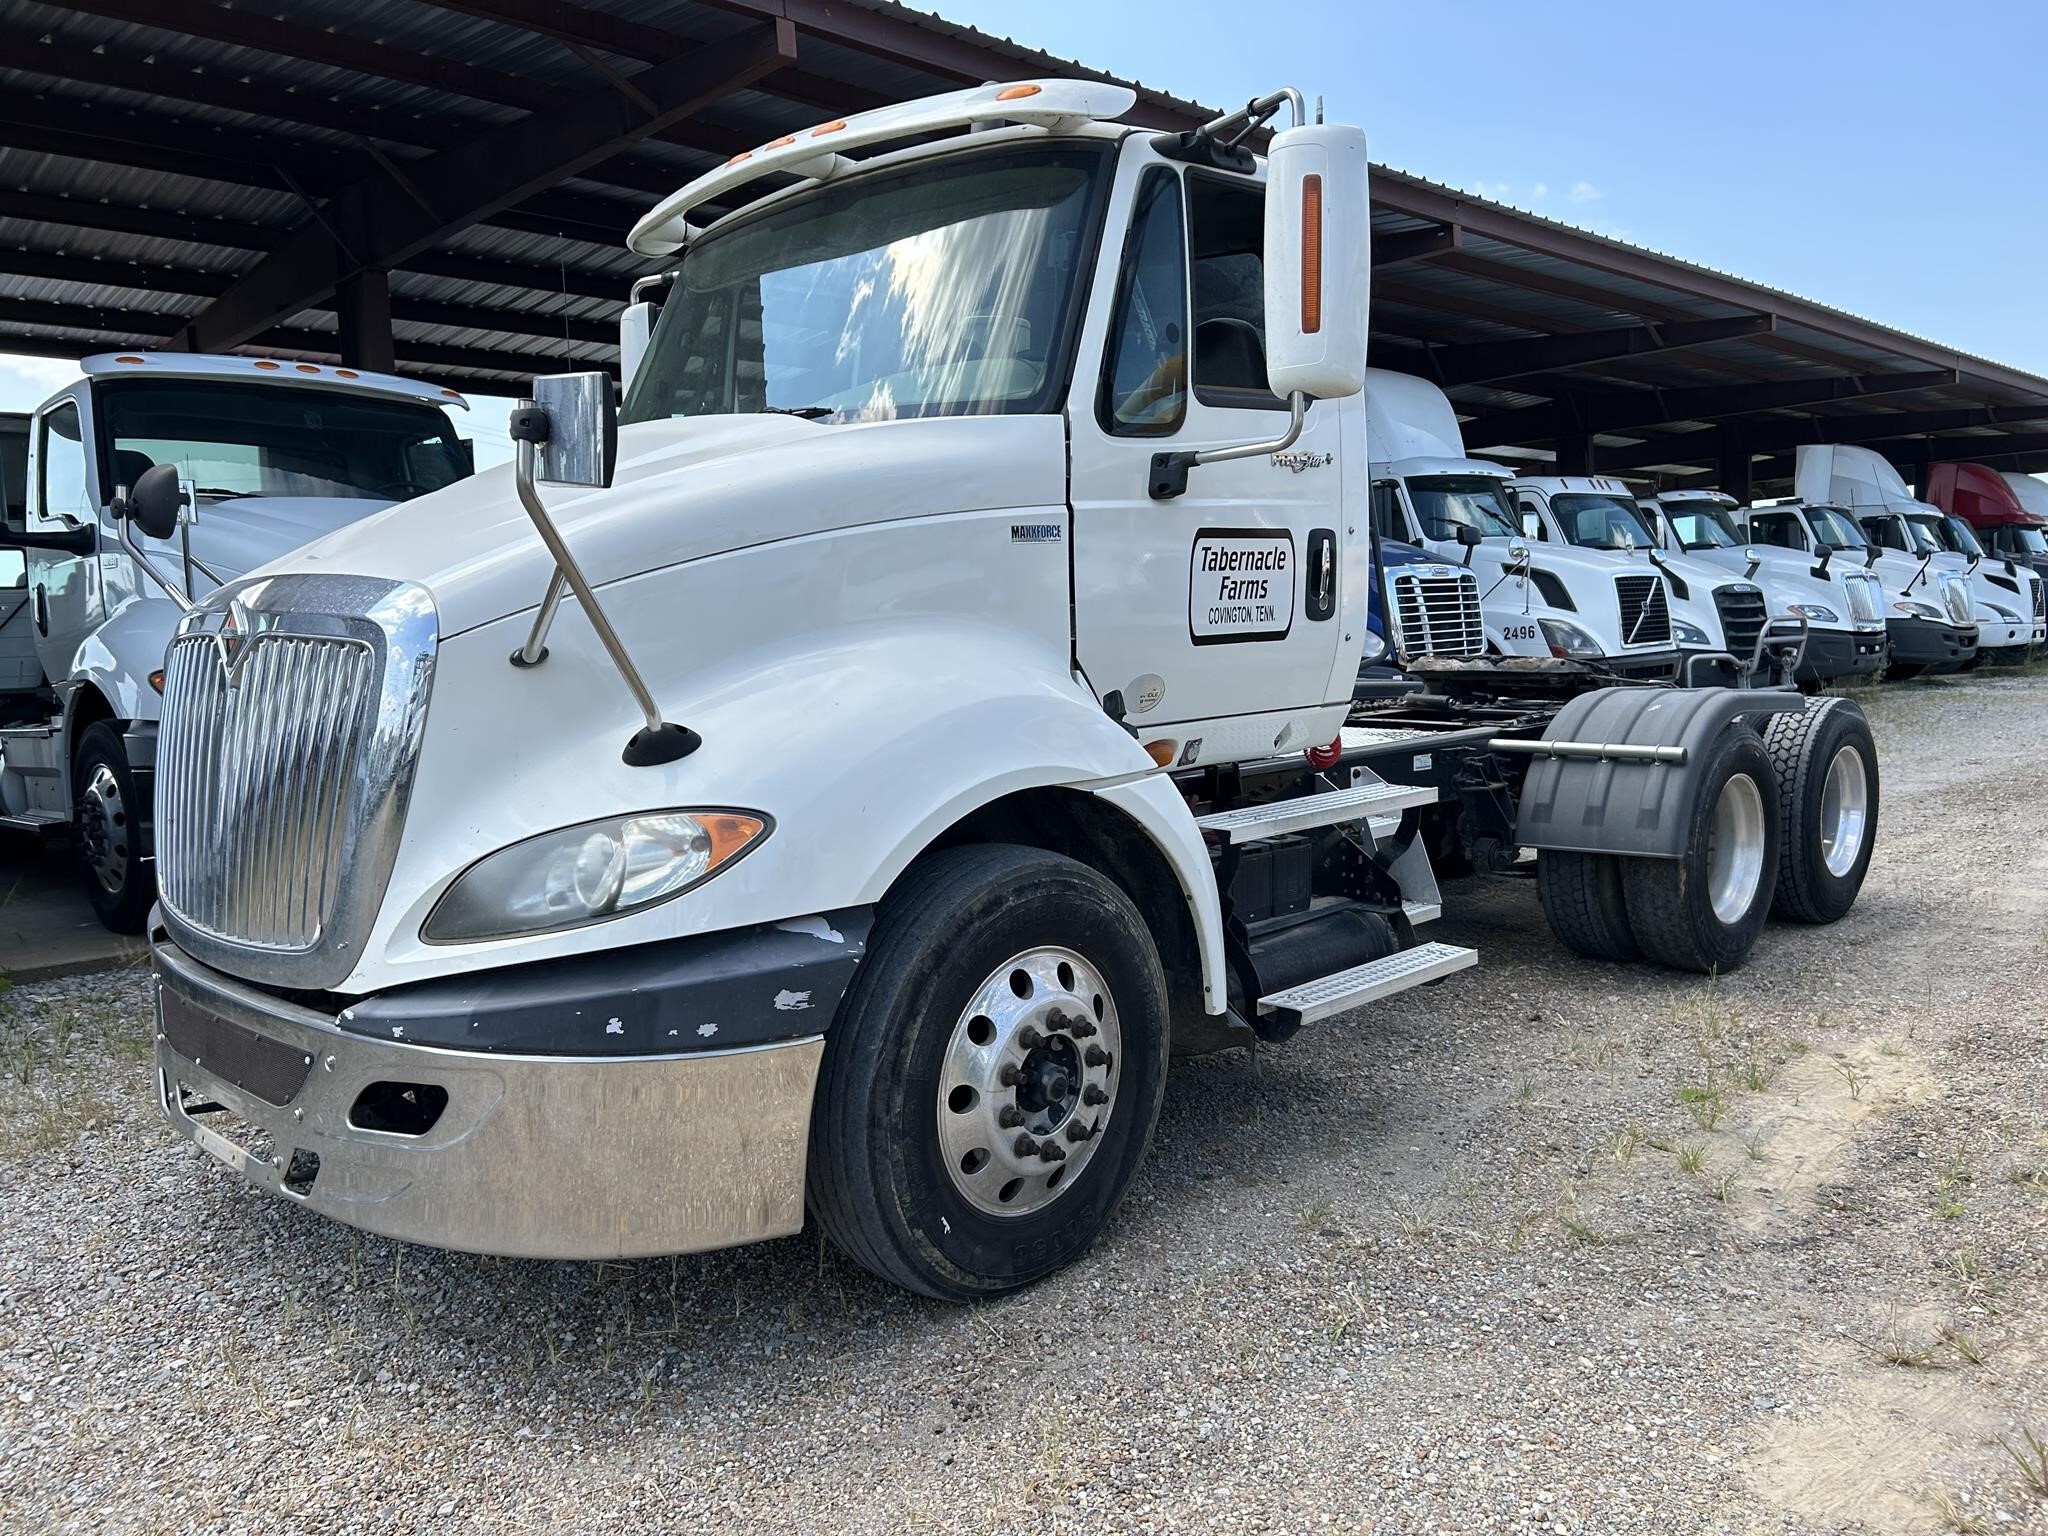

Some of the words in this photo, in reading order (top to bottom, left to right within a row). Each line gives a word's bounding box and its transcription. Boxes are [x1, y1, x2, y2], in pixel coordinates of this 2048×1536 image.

[1201, 546, 1287, 571] Tabernacle
[1219, 576, 1268, 600] Farms
[1208, 606, 1254, 625] COVINGTON,
[1256, 605, 1276, 622] TENN.
[1503, 625, 1535, 640] 2496
